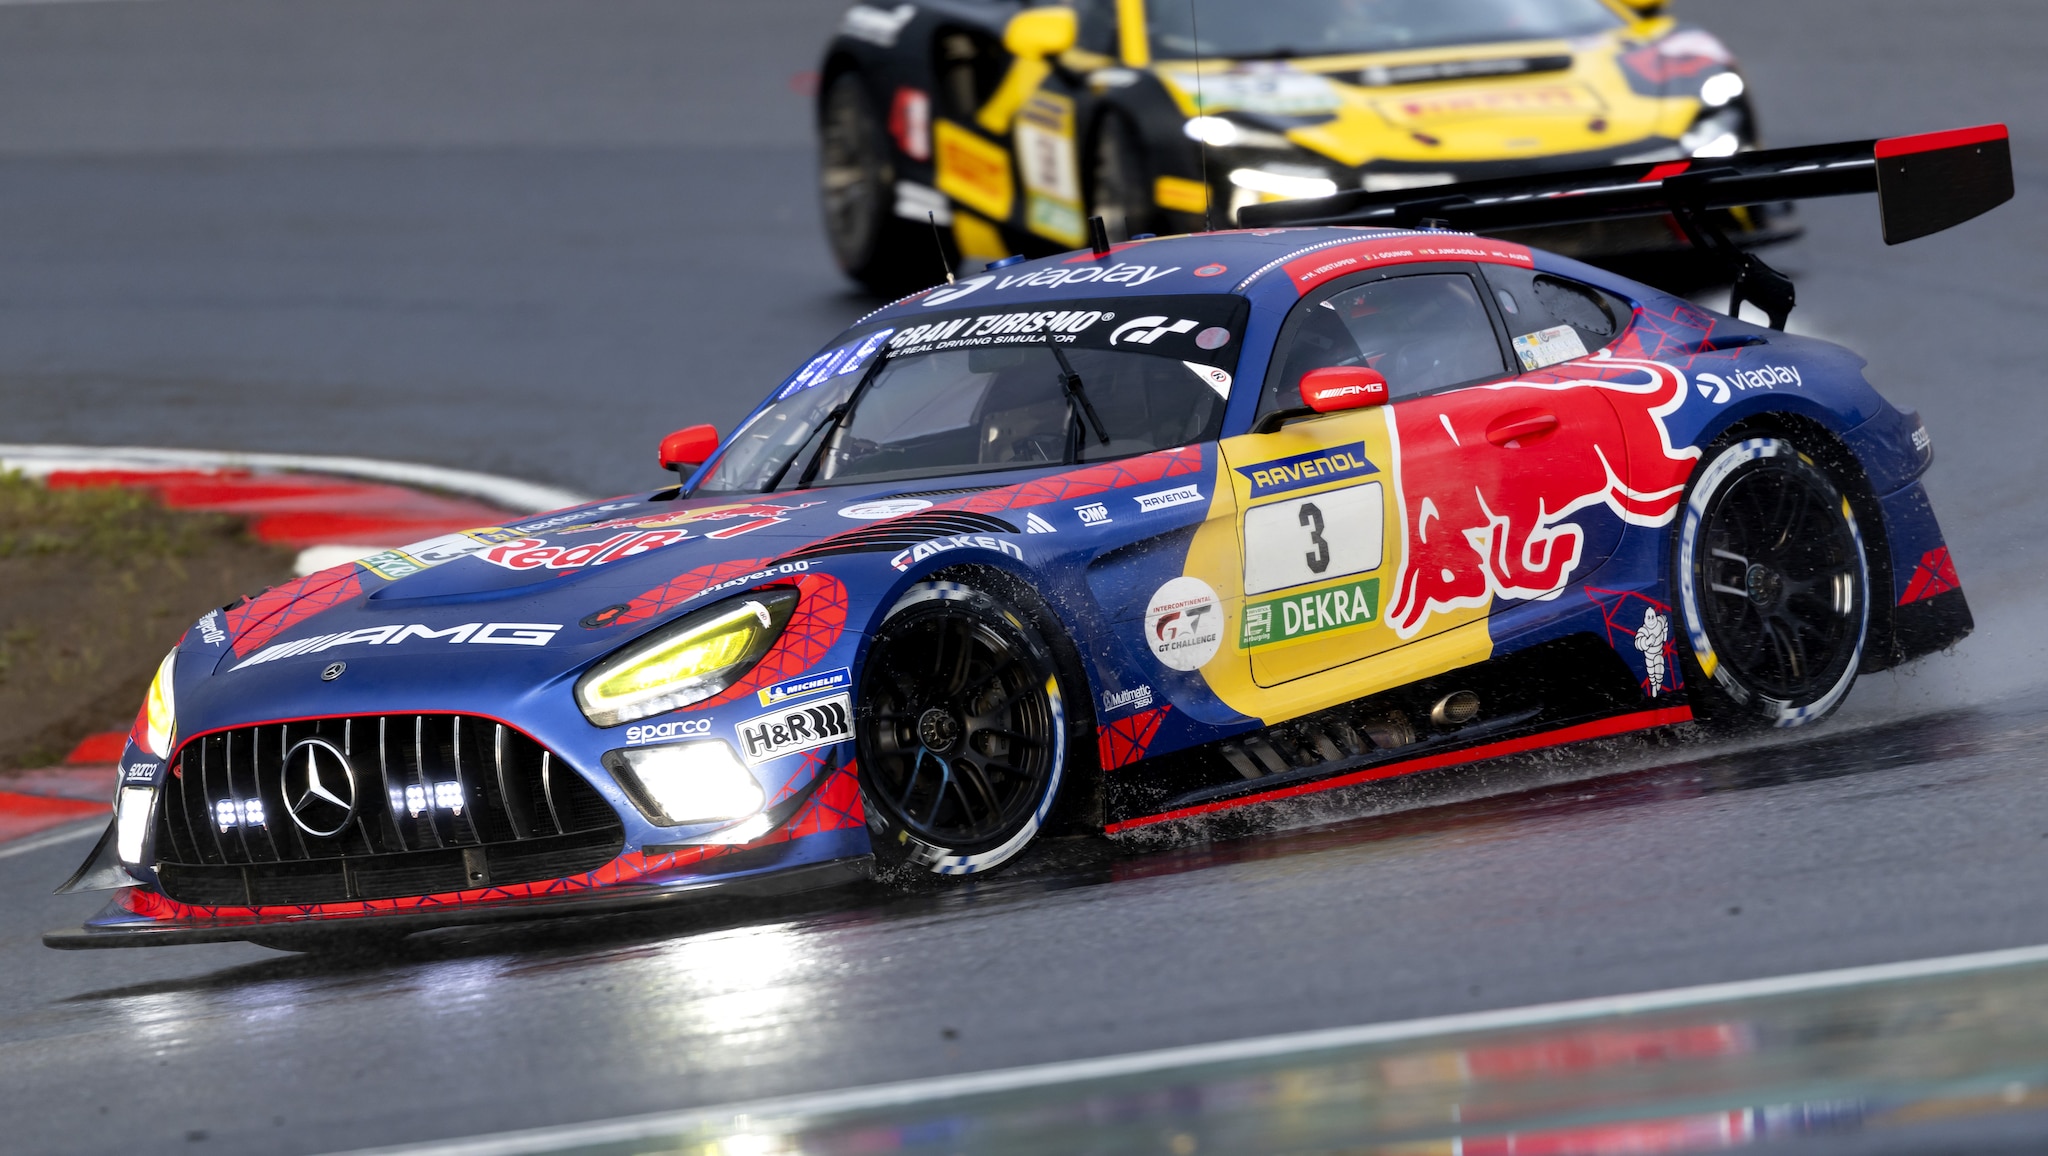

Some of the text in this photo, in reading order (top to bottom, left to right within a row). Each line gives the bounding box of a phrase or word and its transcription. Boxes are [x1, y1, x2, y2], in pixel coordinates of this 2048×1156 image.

[995, 262, 1182, 290] viaplay
[1314, 258, 1357, 274] VERSTAPPEN
[888, 317, 972, 349] GRAN
[900, 343, 933, 356] REAL
[936, 336, 992, 350] DRIVING
[1726, 364, 1802, 391] viaplay
[1252, 451, 1366, 488] RAVENOL
[1142, 490, 1197, 508] RAVENOL
[1077, 506, 1109, 522] OMP
[1298, 502, 1330, 574] 3
[890, 536, 1024, 572] FALKEN
[699, 560, 809, 597] Player 0.0
[1153, 596, 1211, 613] INTERCONTINENTAL
[1282, 586, 1371, 636] DEKRA
[1159, 633, 1217, 652] GT CHALLENGE
[786, 674, 843, 694] MICHELIN
[1111, 684, 1151, 706] Multimatic
[626, 718, 712, 744] sparco
[745, 714, 812, 755] H&R
